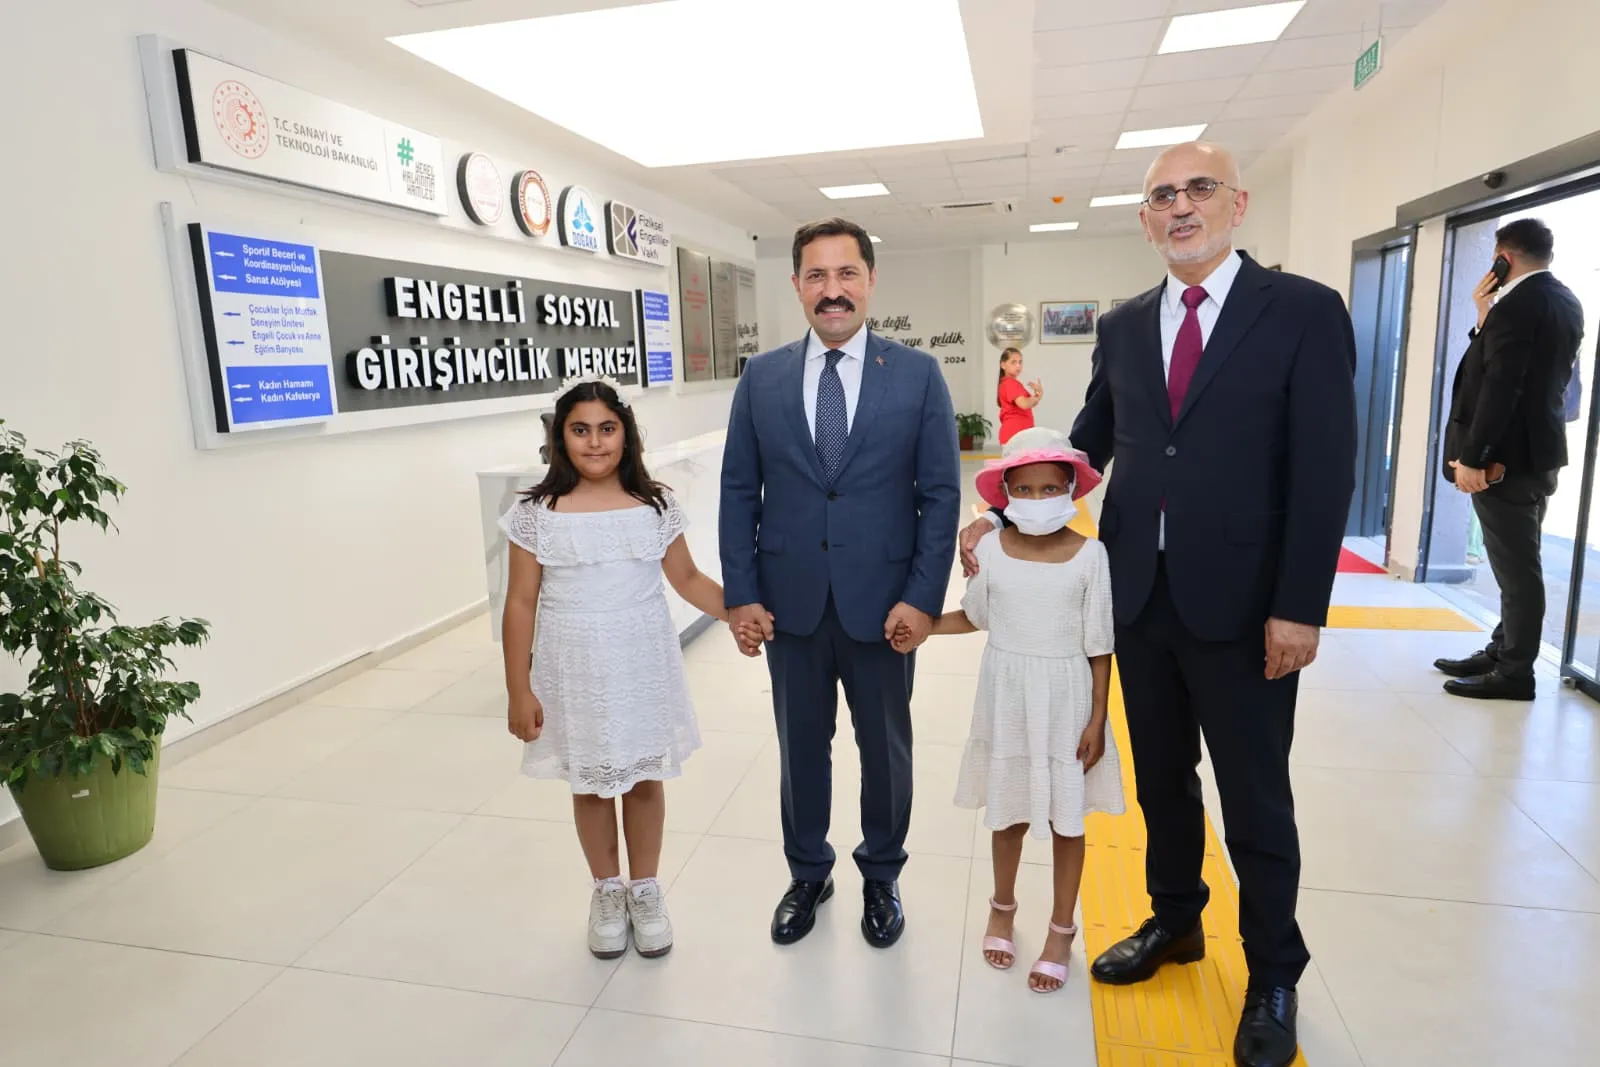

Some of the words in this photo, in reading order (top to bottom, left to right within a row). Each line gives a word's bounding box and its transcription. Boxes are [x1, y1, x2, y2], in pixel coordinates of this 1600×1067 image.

[273, 116, 292, 132] T.C.
[293, 122, 329, 142] SANAYİ
[330, 134, 343, 146] VE
[275, 133, 330, 159] TEKNOLOJİ
[331, 149, 378, 171] BAKANLIĞI
[572, 231, 597, 249] DOĞAKA
[242, 244, 270, 257] Sportif
[271, 248, 297, 260] Beceri
[243, 258, 292, 273] Koordinasyon
[245, 274, 269, 285] Sanat
[270, 276, 302, 288] Atölyesi
[386, 277, 526, 323] ENGELLİ
[537, 293, 620, 328] SOSYAL
[281, 317, 305, 328] Ünitesi
[350, 335, 553, 391] GİRİŞİMCİLİK
[944, 356, 966, 364] 2024
[259, 380, 281, 390] Kadın
[261, 393, 284, 402] Kadın
